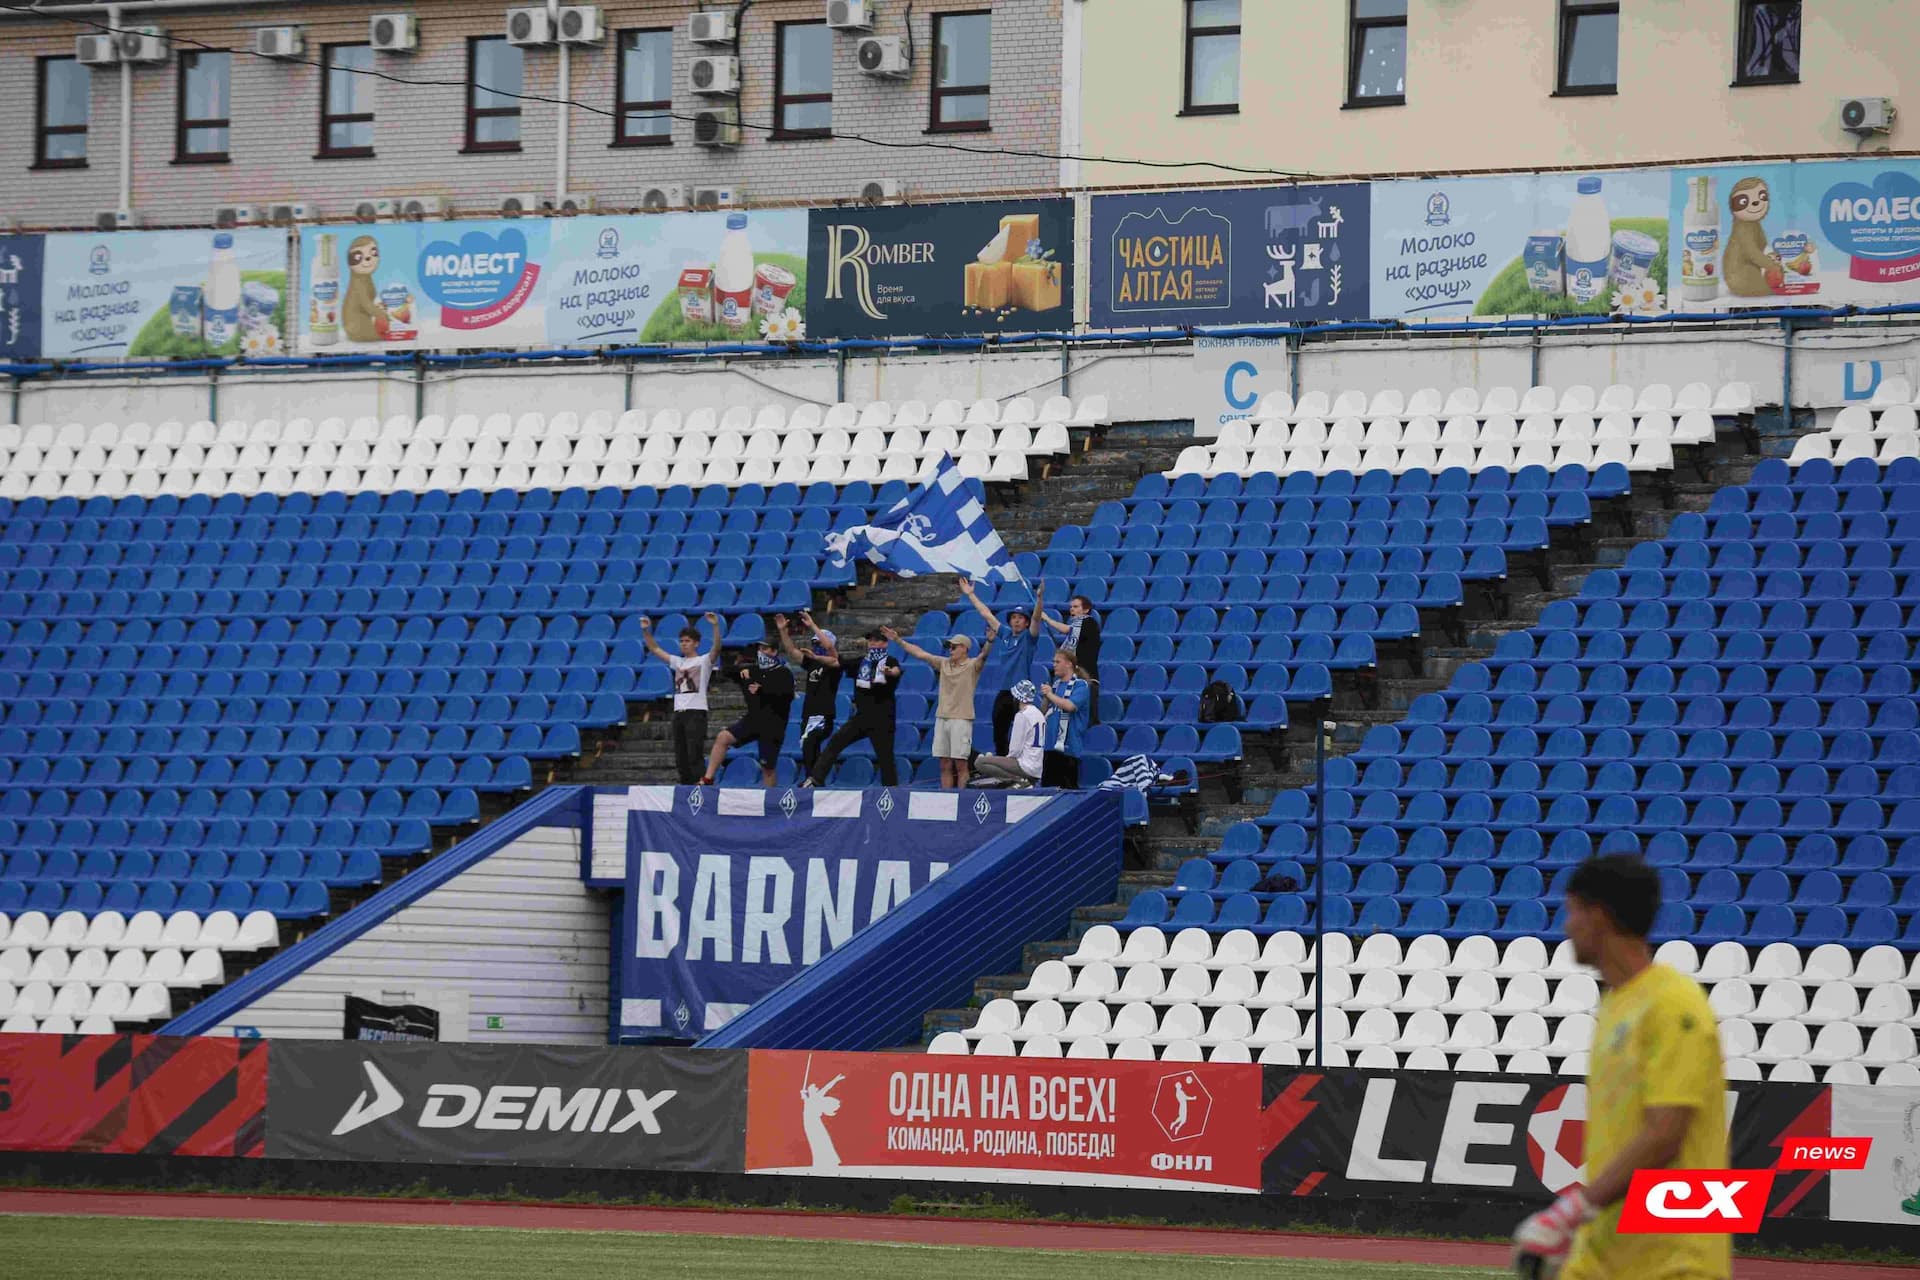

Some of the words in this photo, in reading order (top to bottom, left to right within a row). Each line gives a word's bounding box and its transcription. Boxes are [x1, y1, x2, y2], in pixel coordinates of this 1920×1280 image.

[1119, 233, 1224, 270] ЧАСТИЦА
[1400, 231, 1475, 256] Молоко
[425, 252, 520, 278] МОДЕСТ
[573, 264, 640, 286] Молоко
[1386, 264, 1411, 281] на
[1416, 253, 1488, 281] разные
[67, 280, 130, 301] Молоко
[560, 295, 582, 310] на
[585, 284, 649, 310] разные
[877, 283, 904, 296] Время
[1119, 269, 1194, 303] АЛТАЯ
[1405, 279, 1472, 301] «хочу»
[876, 296, 892, 305] для
[893, 295, 916, 305] вкуса
[577, 308, 636, 328] «хочу»
[1224, 360, 1258, 410] C
[635, 850, 950, 966] BARNA
[417, 1083, 678, 1135] DEMIX
[888, 1071, 970, 1122] ОДНА
[981, 1075, 1021, 1120] НА
[1029, 1075, 1117, 1123] ВСЕХ!
[888, 1126, 970, 1155] КОМАНДА,
[973, 1130, 1042, 1157] РОДИНА,
[1046, 1131, 1116, 1158] ПОБЕДА!
[1150, 1151, 1213, 1171] ФНЛ
